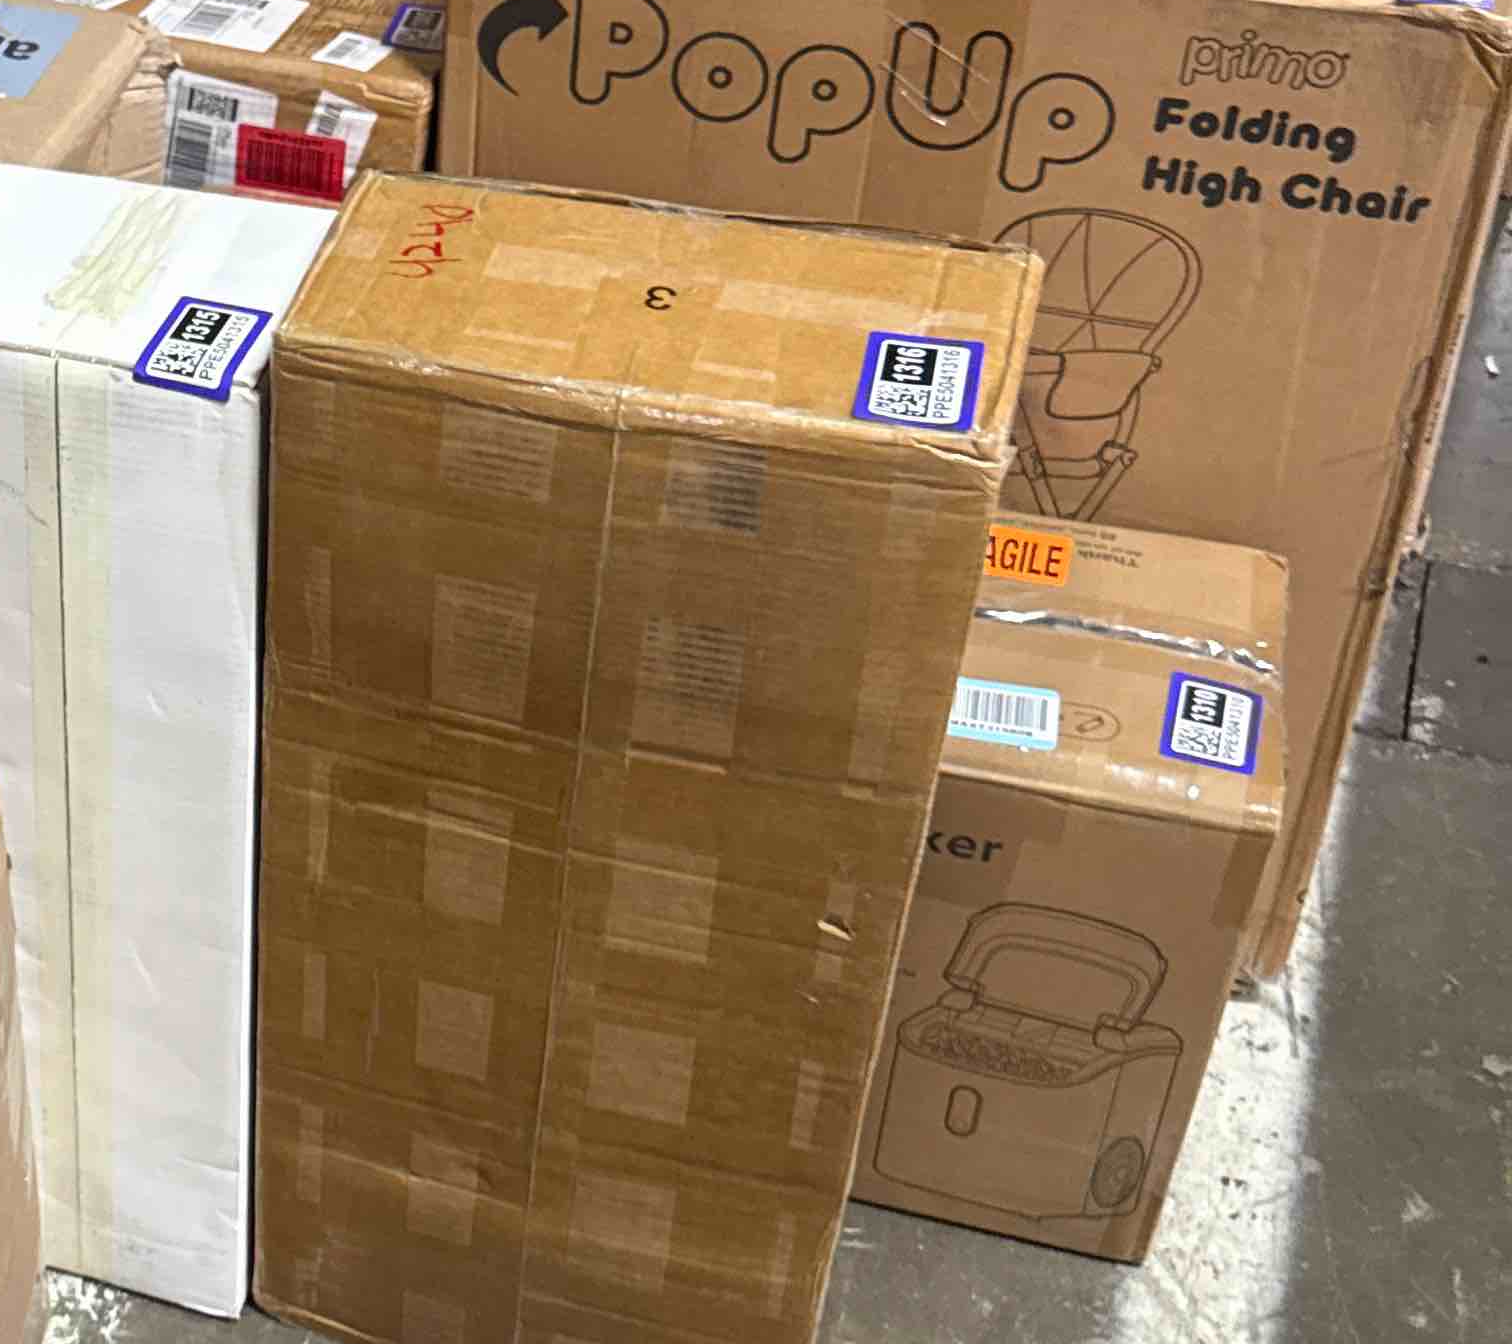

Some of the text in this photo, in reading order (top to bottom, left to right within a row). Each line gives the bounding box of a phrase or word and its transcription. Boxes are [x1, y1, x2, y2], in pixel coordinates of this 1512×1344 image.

[1177, 29, 1349, 93] primo
[1153, 97, 1359, 166] Folding
[1141, 155, 1433, 227] High Chair
[181, 309, 221, 342] 1315
[891, 346, 928, 382] 1316
[932, 349, 961, 419] PPE5041316
[1189, 687, 1219, 724] 1310
